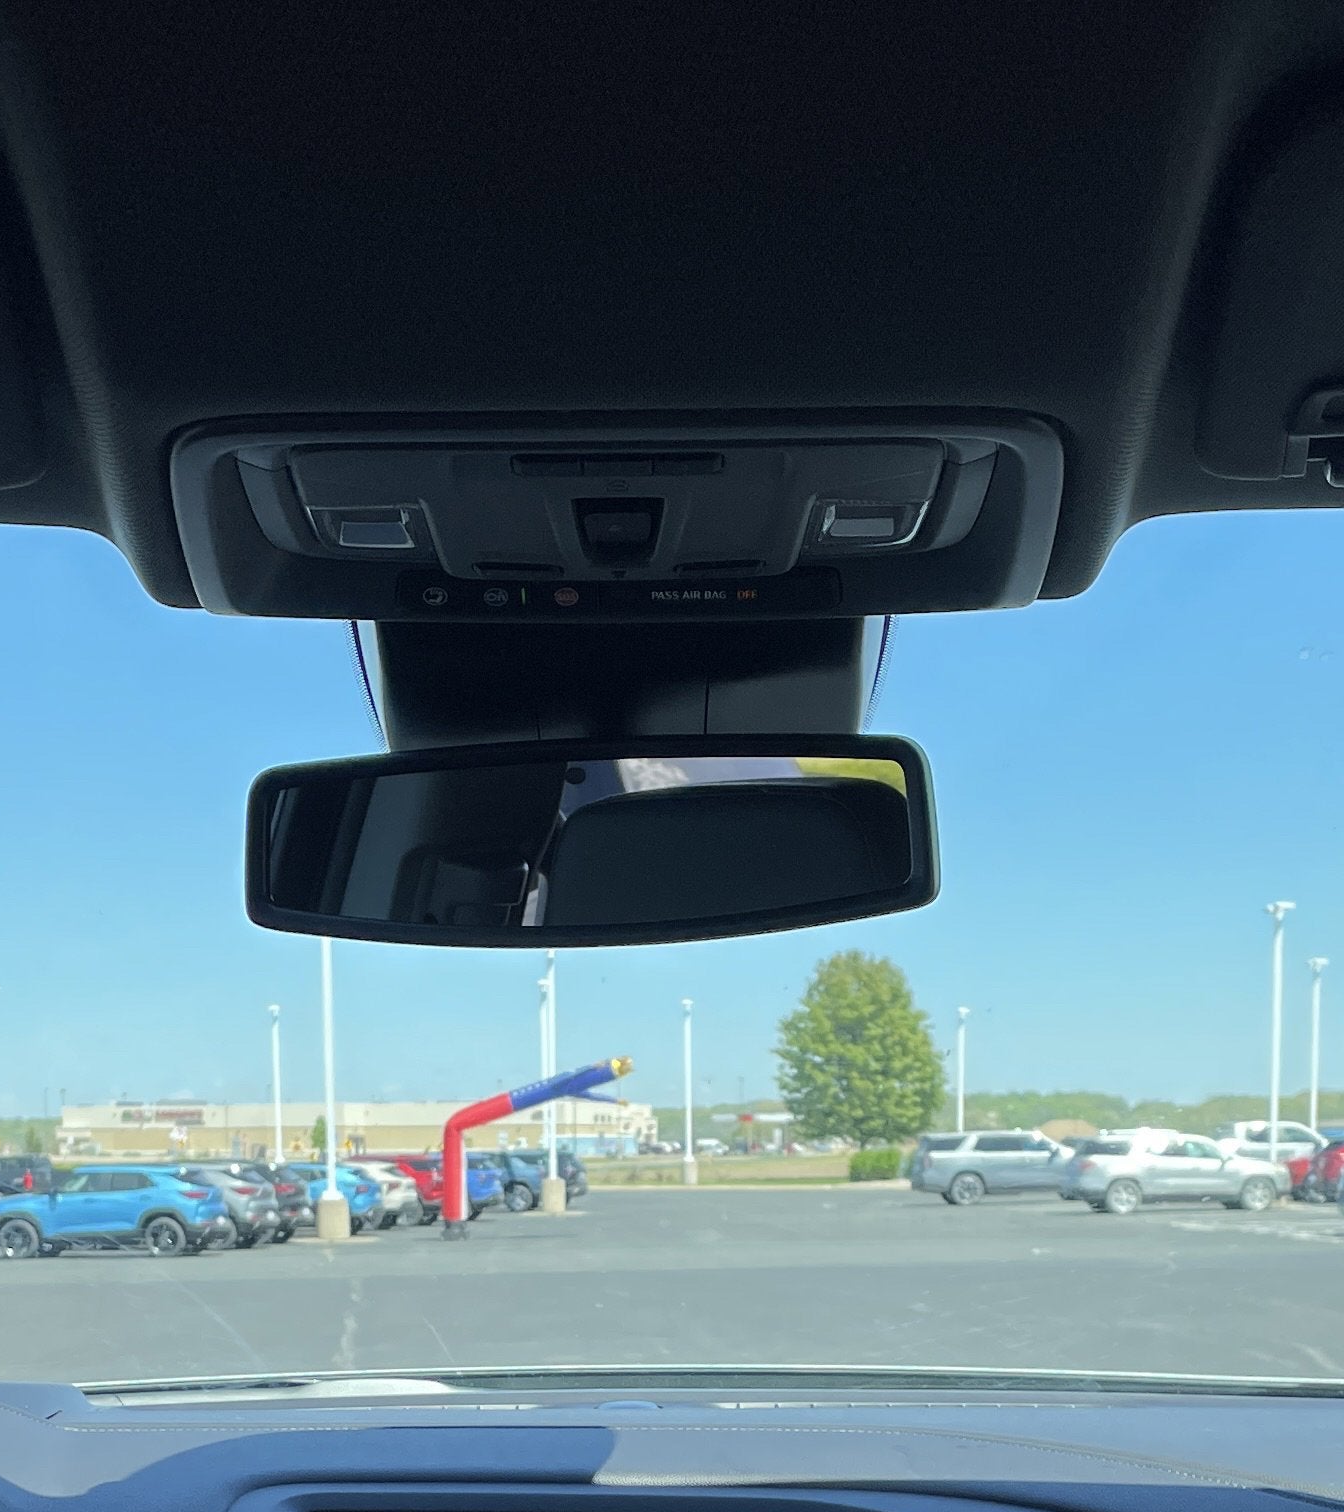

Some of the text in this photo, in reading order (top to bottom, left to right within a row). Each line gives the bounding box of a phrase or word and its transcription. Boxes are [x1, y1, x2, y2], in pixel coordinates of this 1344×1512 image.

[651, 590, 680, 600] PASS
[682, 590, 702, 600] AIR
[704, 590, 727, 600] BAG
